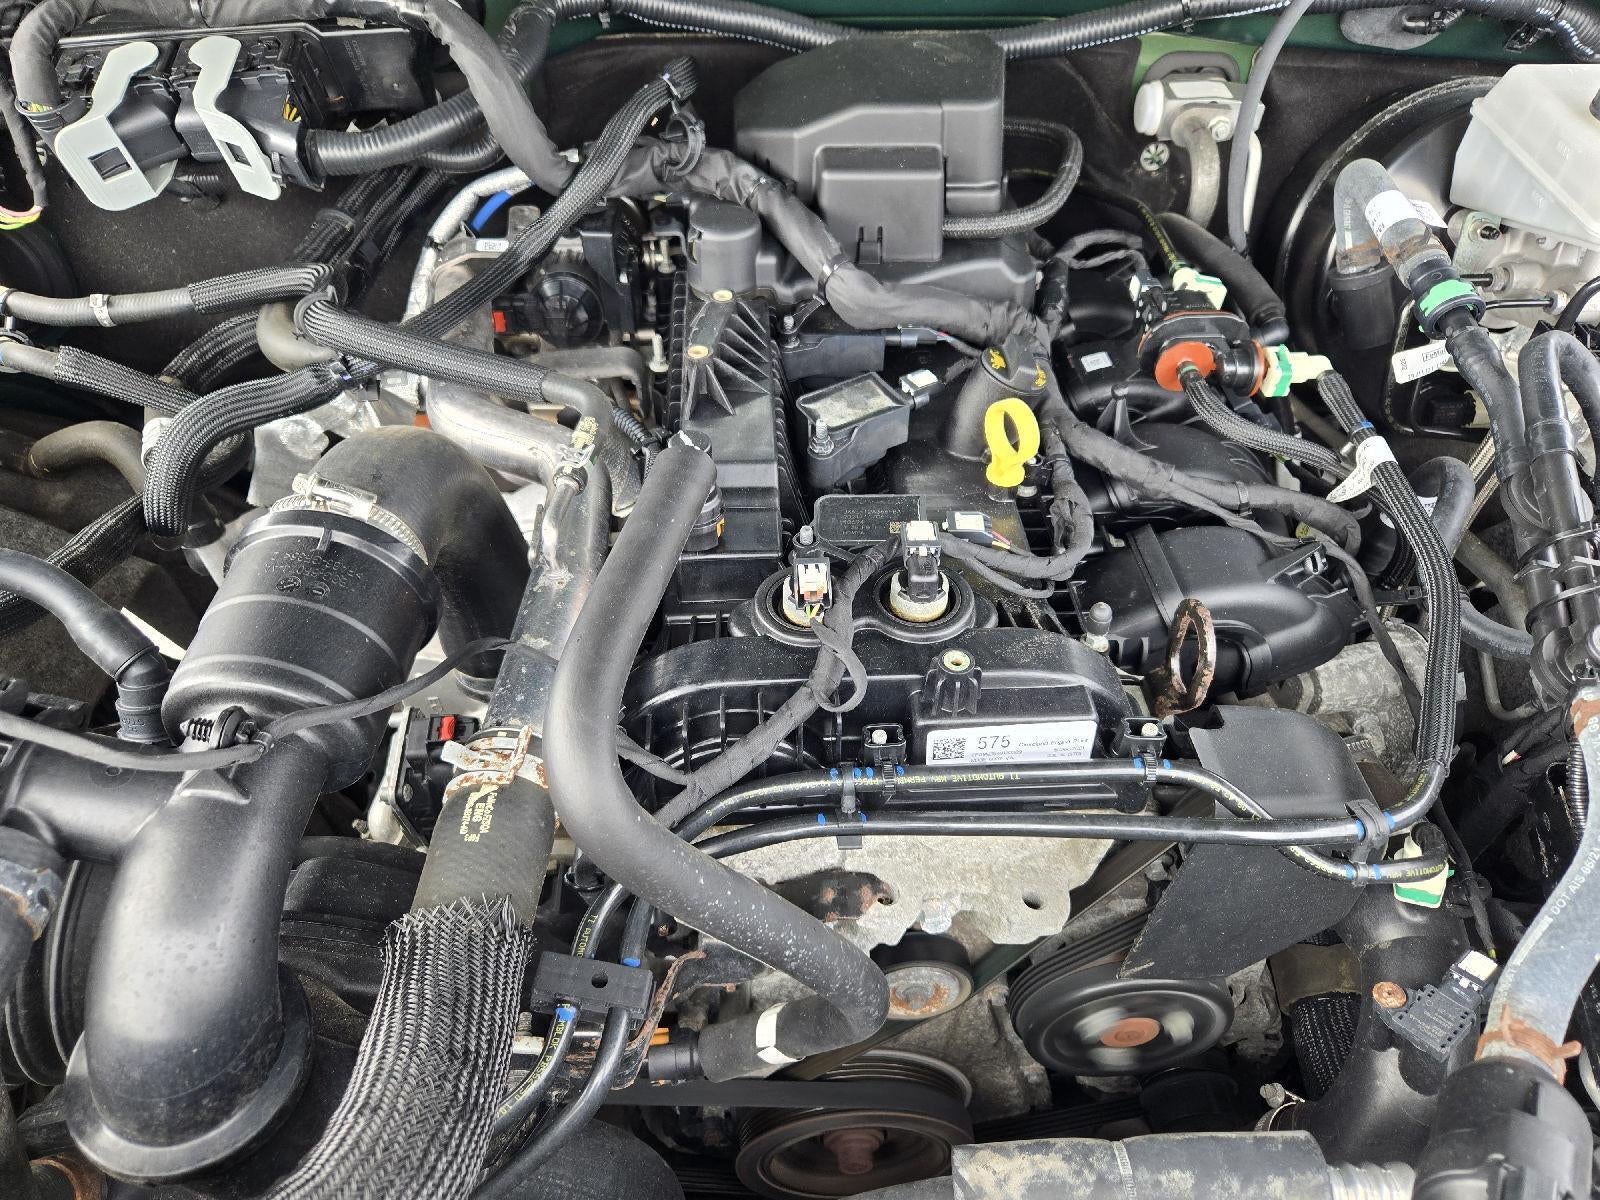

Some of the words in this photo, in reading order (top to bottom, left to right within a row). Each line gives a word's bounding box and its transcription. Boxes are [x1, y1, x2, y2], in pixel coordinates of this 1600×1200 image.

[977, 735, 1011, 750] 575
[950, 773, 1005, 782] AUTOMOTIVE
[587, 914, 599, 924] TI
